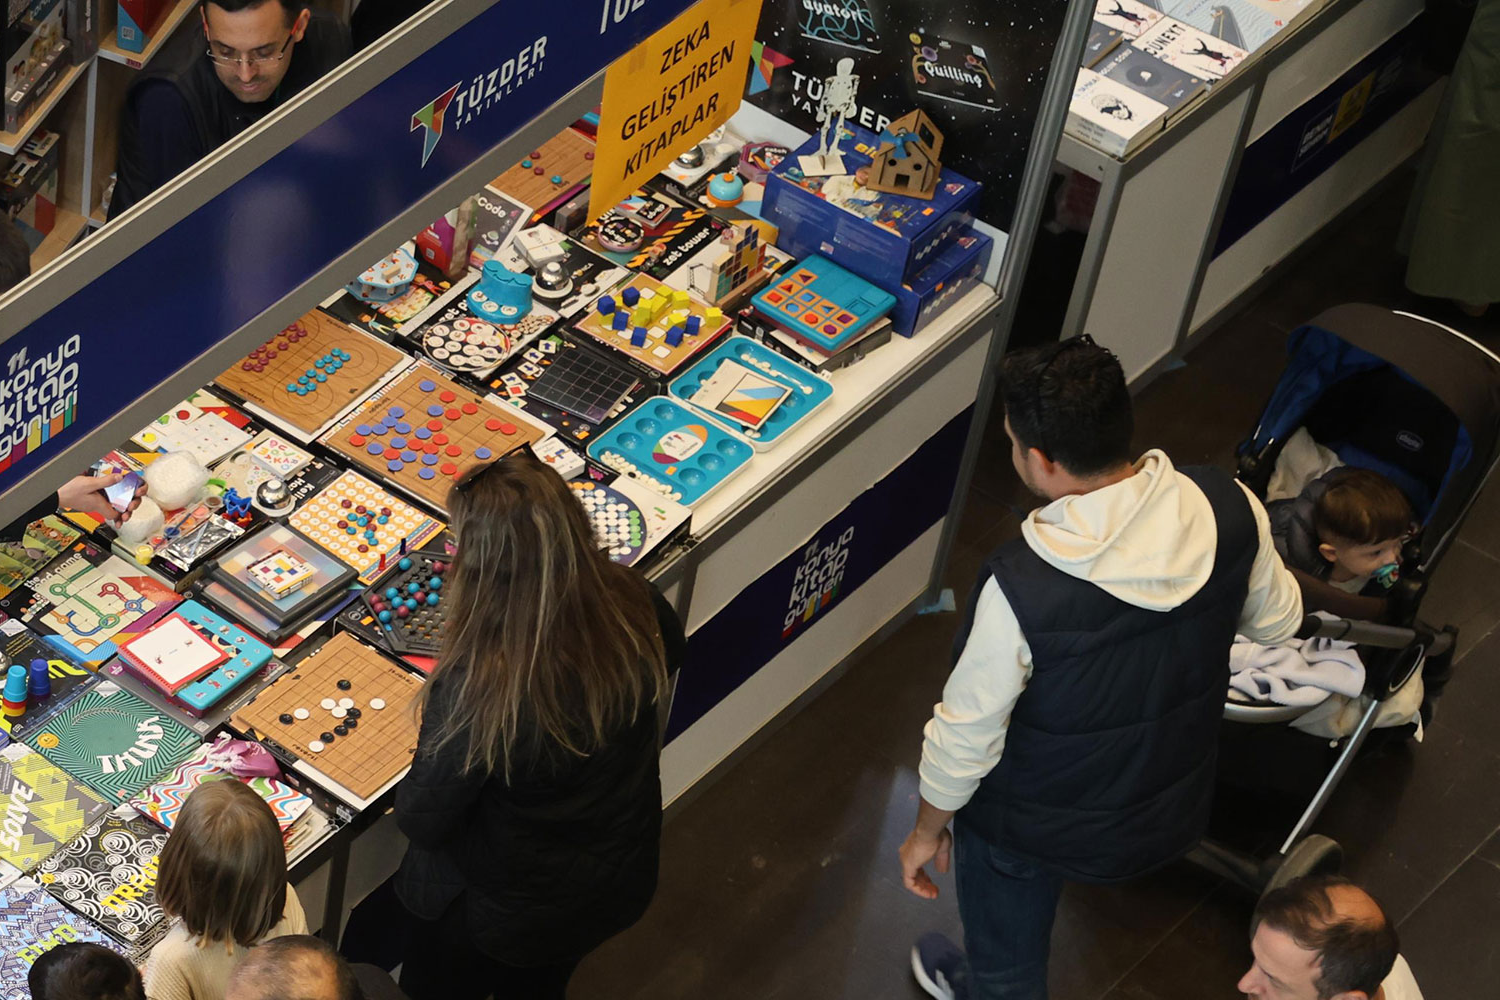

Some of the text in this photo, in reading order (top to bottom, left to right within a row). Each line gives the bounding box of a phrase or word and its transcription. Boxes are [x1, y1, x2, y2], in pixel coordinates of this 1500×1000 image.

[456, 36, 548, 118] TÜZDER
[660, 20, 710, 75] ZEKA
[924, 60, 983, 89] Quilling
[455, 61, 544, 131] YAYINLARI
[621, 40, 736, 141] GELİŞTİREN
[791, 70, 891, 134] TÜER
[622, 92, 721, 181] KİTAPLAR
[477, 195, 507, 219] Code
[662, 227, 712, 267] zet tower
[0, 333, 81, 404] konya
[7, 345, 32, 376] 11.
[24, 576, 41, 588] the
[789, 548, 849, 610] kitap
[795, 525, 855, 583] konya
[96, 715, 165, 774] THINK
[0, 779, 35, 853] SOLVE
